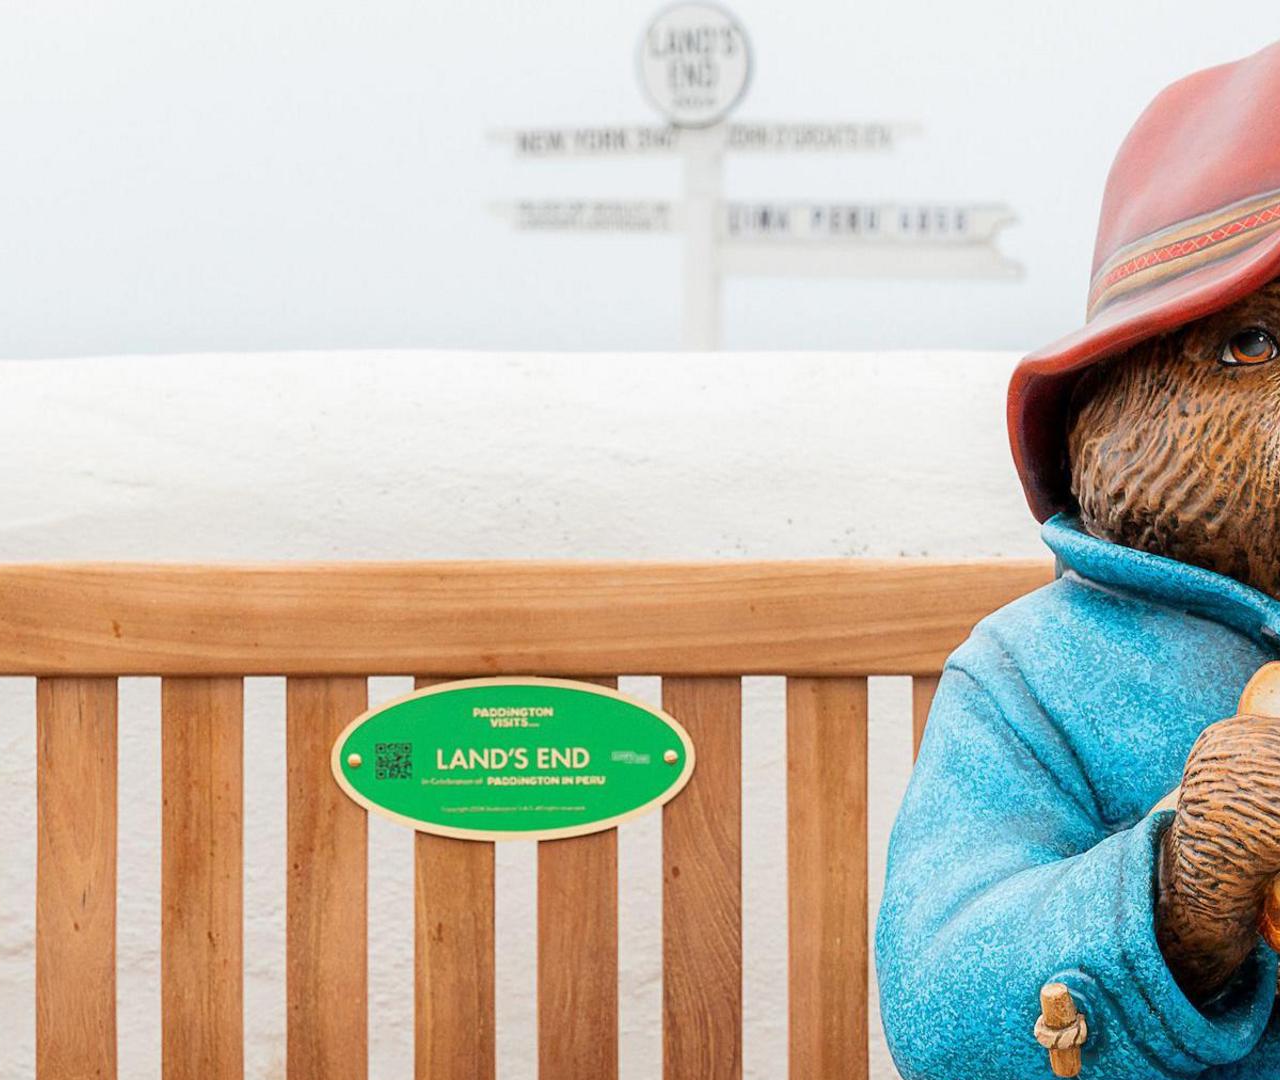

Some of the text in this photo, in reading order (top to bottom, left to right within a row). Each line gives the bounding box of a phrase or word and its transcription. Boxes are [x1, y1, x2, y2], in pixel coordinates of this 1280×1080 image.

[668, 60, 717, 91] END
[516, 131, 565, 151] NEW
[575, 129, 626, 150] YORK
[811, 207, 880, 234] PERU
[436, 747, 529, 770] LAND'S
[537, 747, 590, 769] END
[562, 776, 573, 785] IN
[575, 776, 606, 785] PERU
